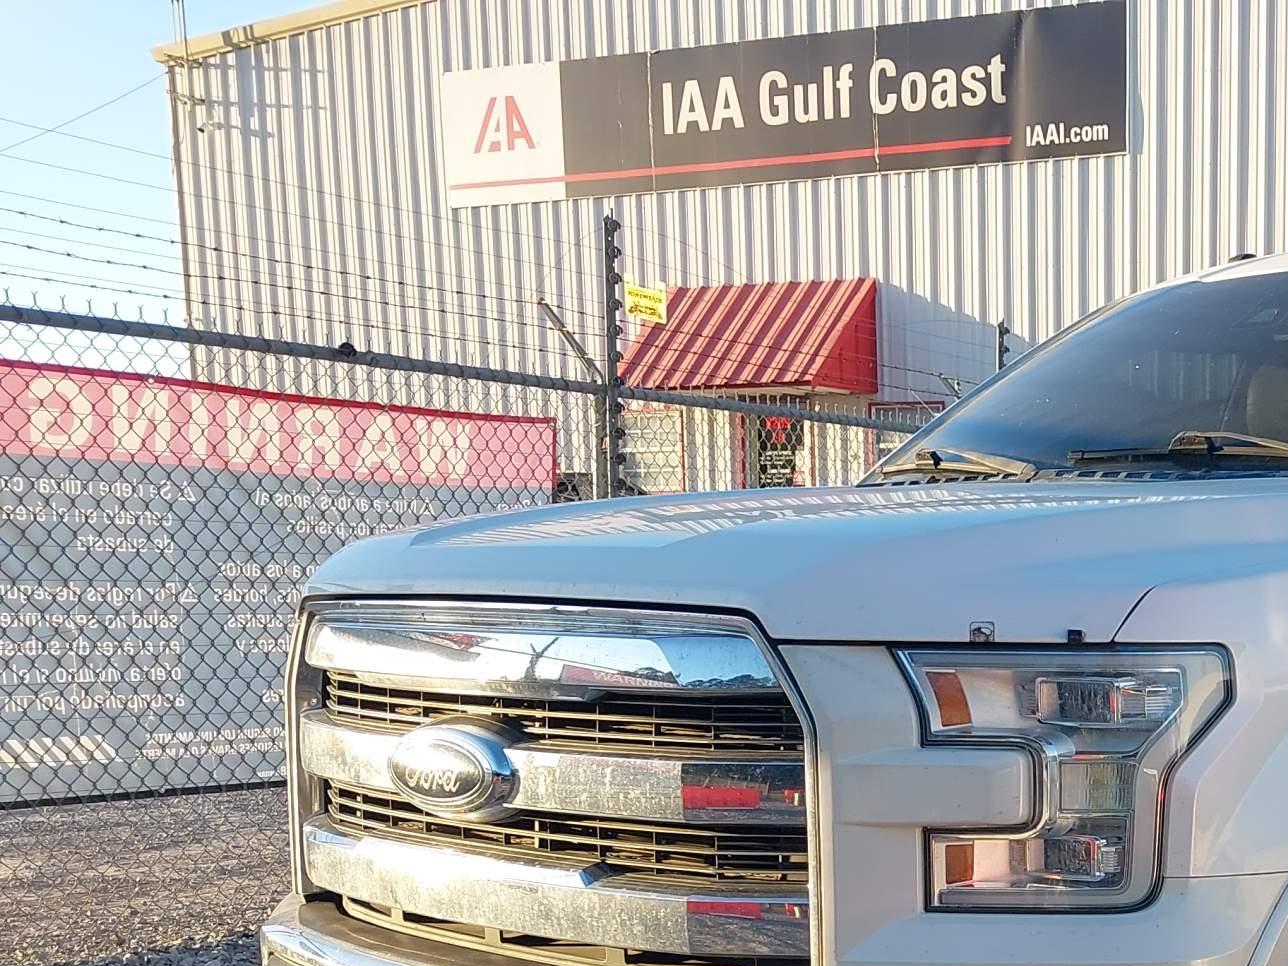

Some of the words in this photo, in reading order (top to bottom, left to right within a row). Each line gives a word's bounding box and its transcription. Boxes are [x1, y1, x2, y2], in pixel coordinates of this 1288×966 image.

[662, 76, 745, 135] IAA
[759, 63, 854, 126] Gulf
[869, 54, 1007, 115] Coast
[1025, 122, 1109, 147] IAAI.com
